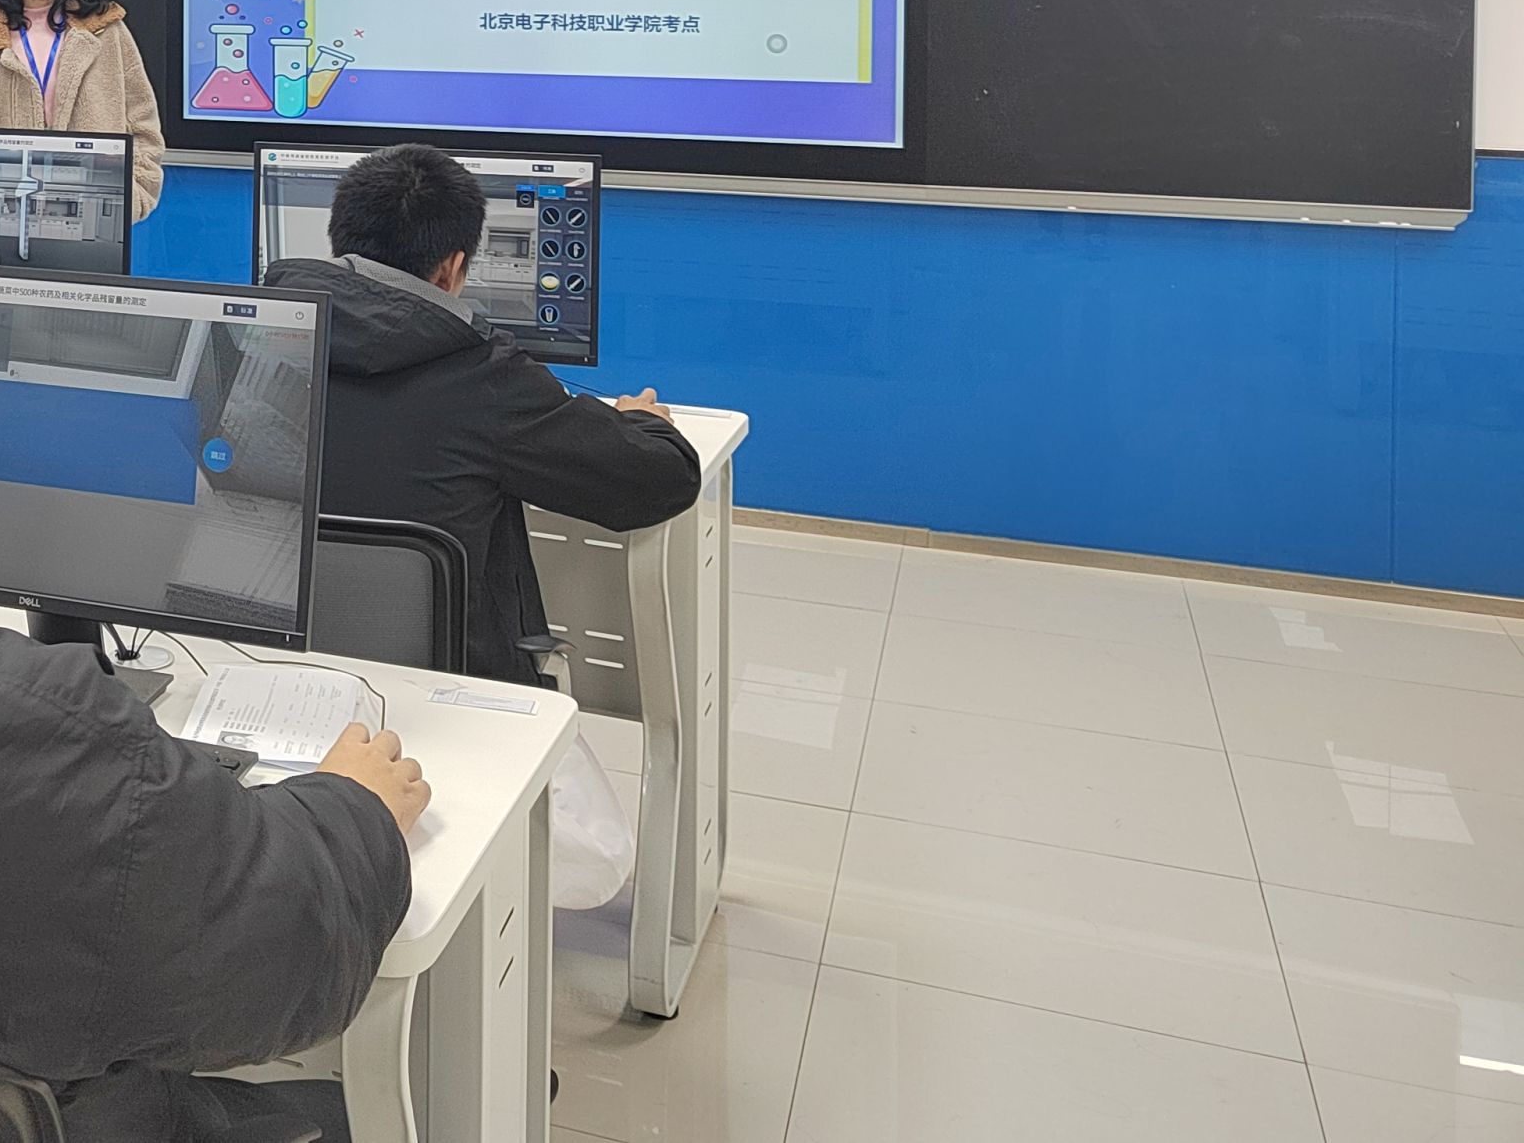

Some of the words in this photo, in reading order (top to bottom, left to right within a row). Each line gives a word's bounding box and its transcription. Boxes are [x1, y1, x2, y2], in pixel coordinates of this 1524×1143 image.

[479, 12, 701, 34] 北京电子科技职业学院考点
[18, 596, 41, 608] DELL
